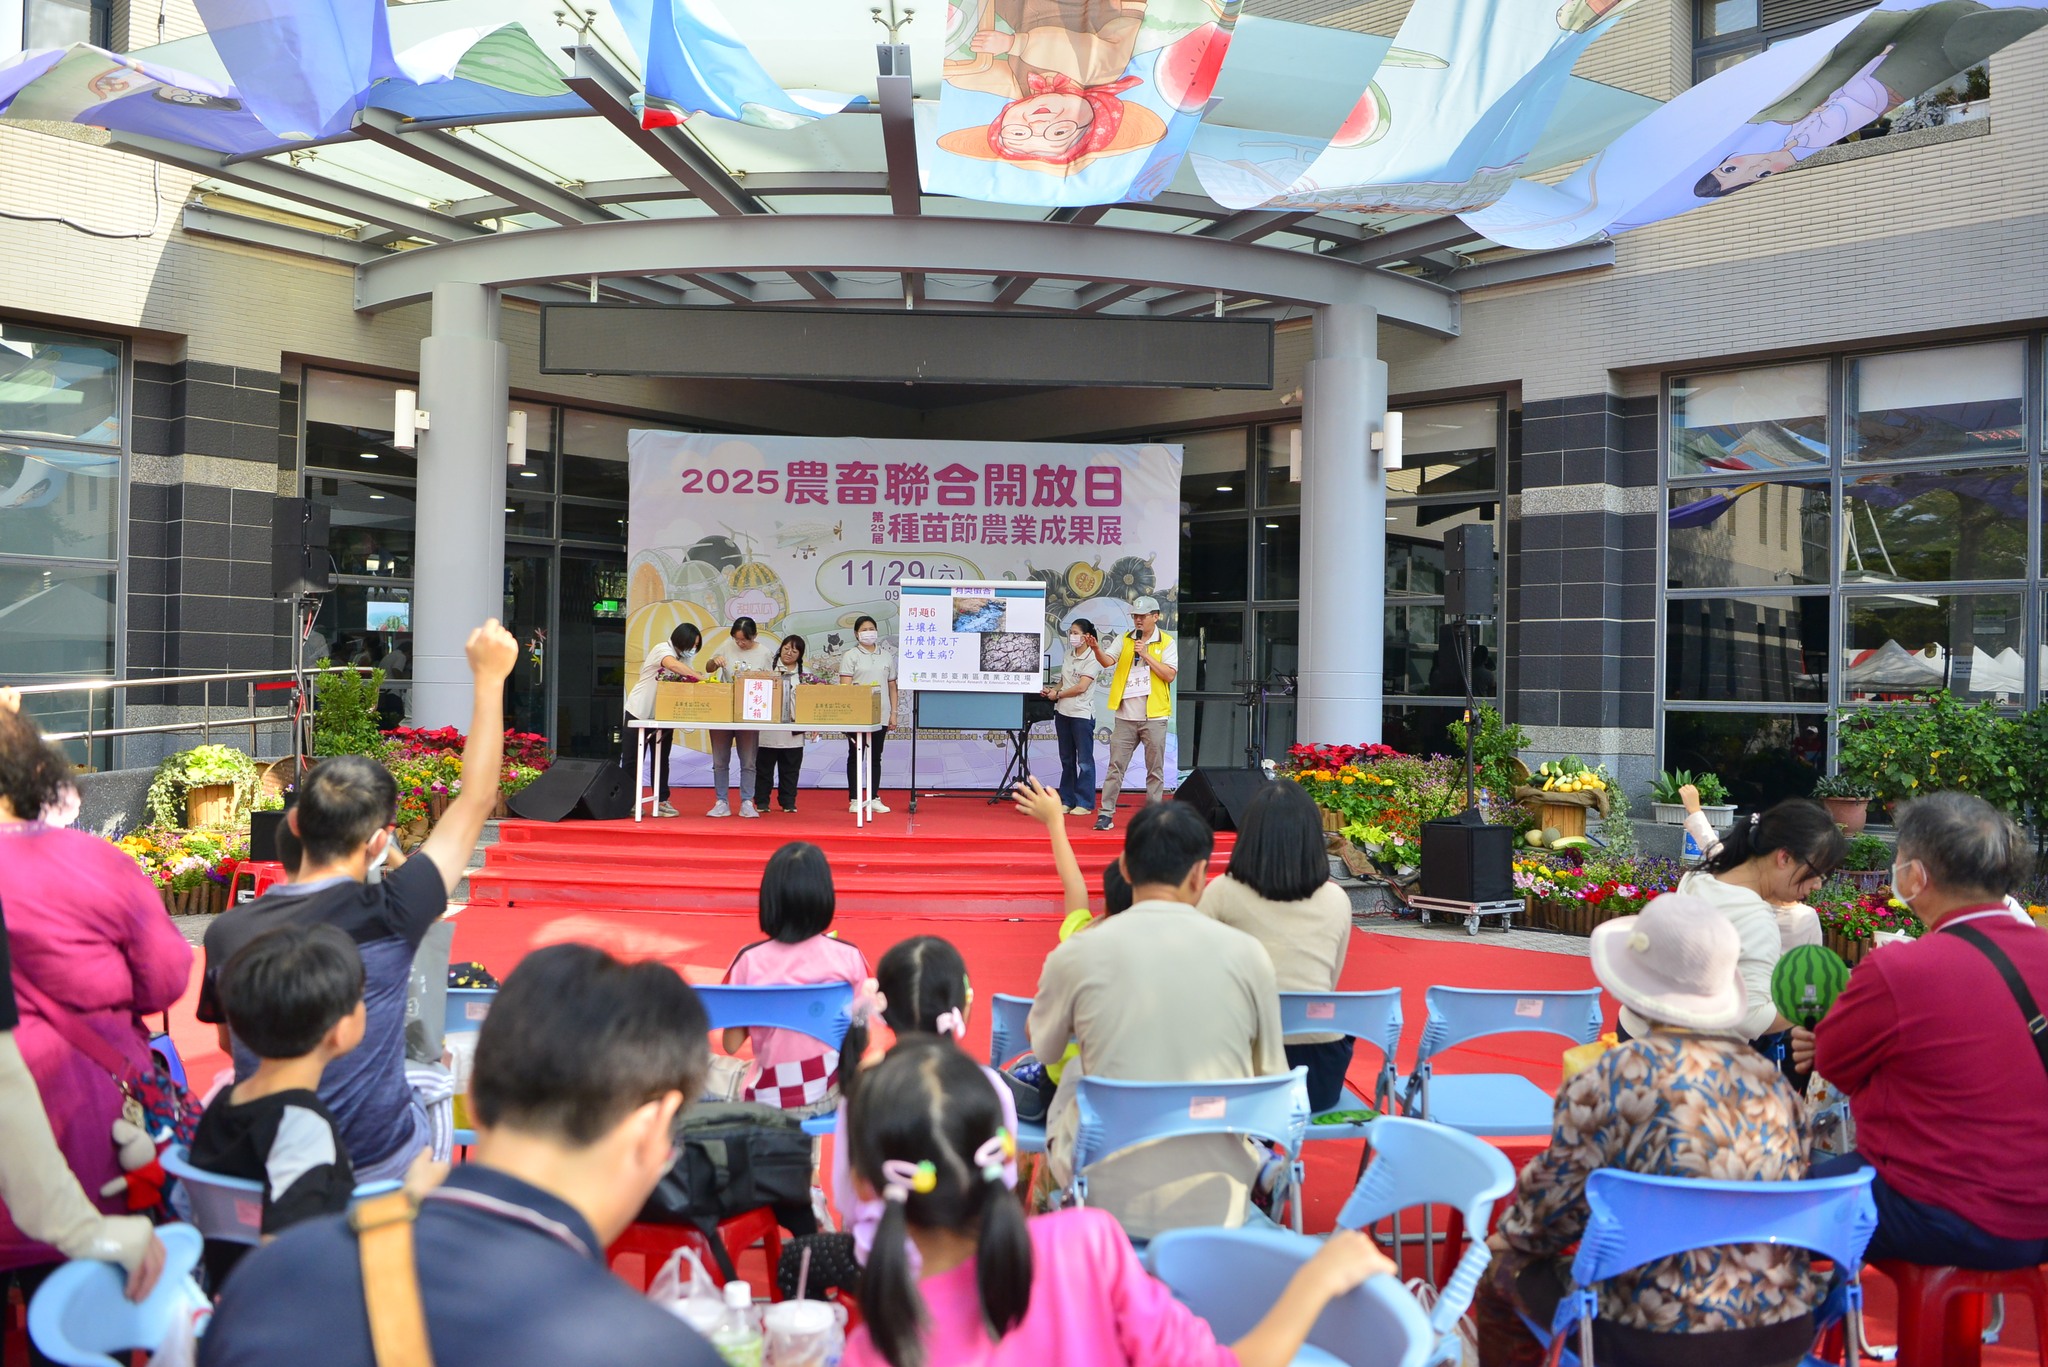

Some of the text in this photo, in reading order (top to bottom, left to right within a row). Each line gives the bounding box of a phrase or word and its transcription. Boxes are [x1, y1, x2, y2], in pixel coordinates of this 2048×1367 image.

[681, 461, 1122, 507] 2025農畜聯合開放日
[887, 512, 1122, 545] 種苗節農業成果展
[908, 607, 936, 618] 問題6
[905, 622, 938, 633] 土壤在
[904, 636, 959, 647] 什麼情況下
